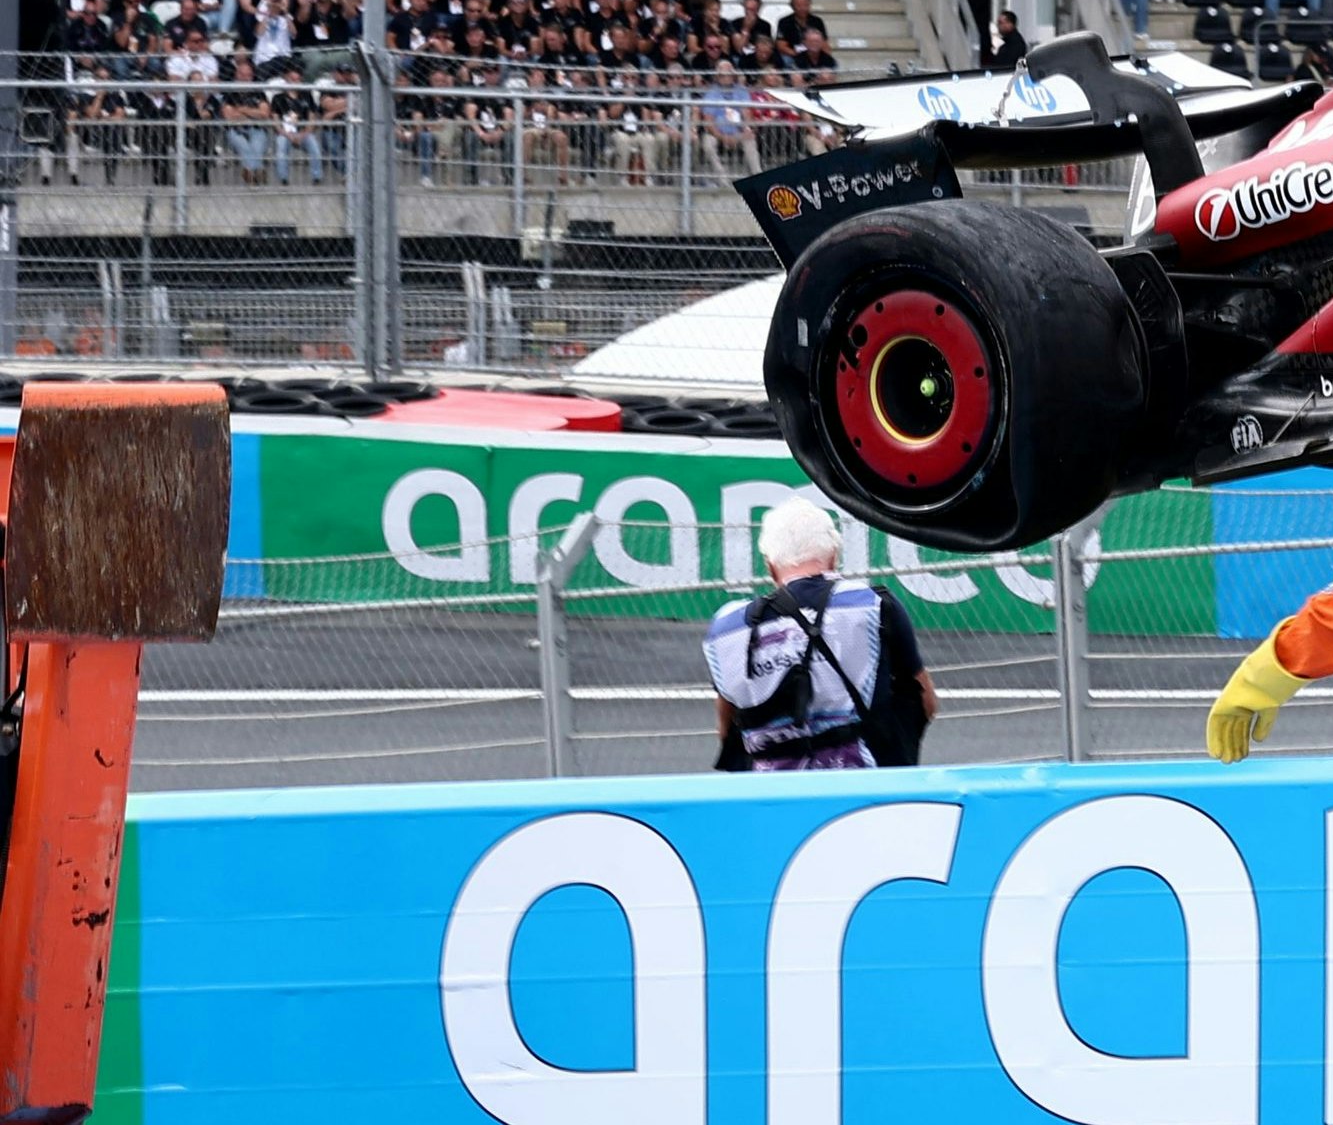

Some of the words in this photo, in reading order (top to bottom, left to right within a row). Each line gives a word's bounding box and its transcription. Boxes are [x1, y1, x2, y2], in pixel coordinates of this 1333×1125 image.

[922, 86, 957, 121] hp
[1017, 80, 1055, 113] hp
[796, 159, 923, 211] V-Power
